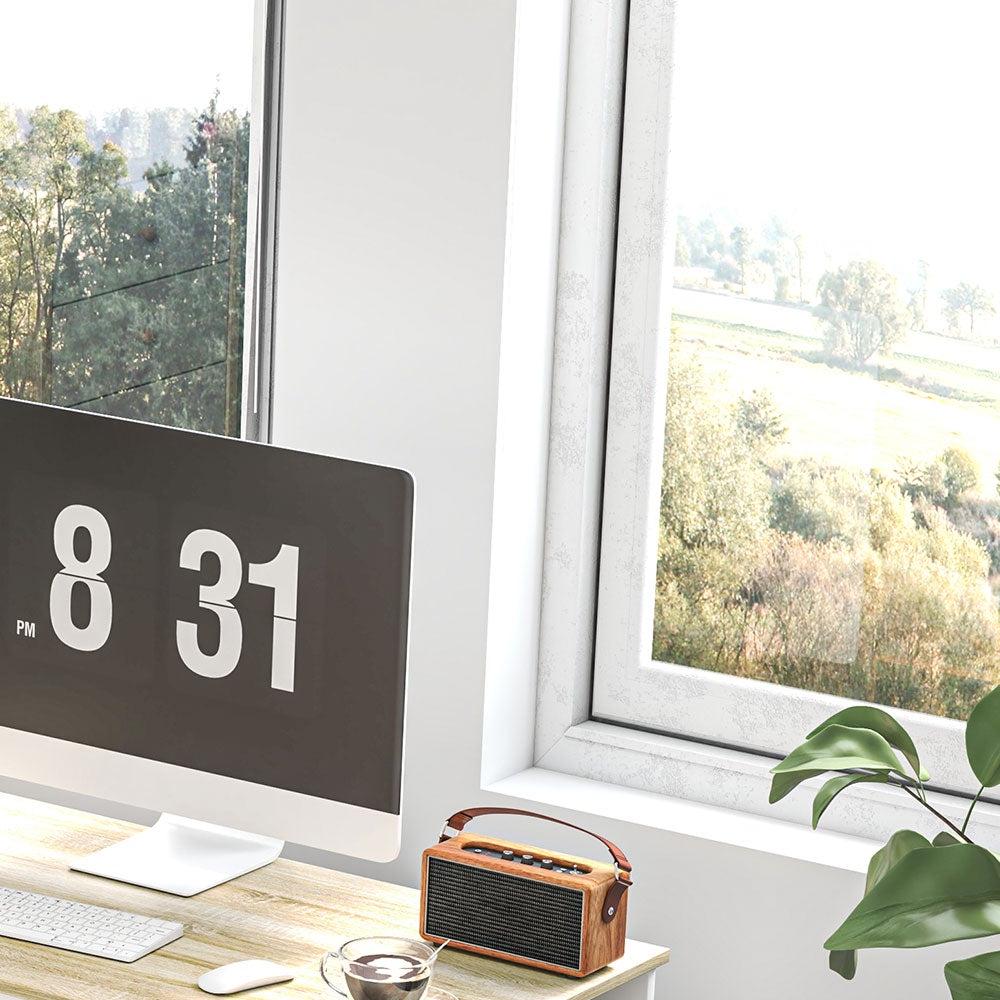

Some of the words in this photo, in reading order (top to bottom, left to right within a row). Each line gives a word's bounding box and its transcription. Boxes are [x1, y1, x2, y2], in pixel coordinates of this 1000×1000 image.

[16, 619, 36, 638] PM
[49, 504, 113, 652] 8
[176, 528, 300, 693] 31
